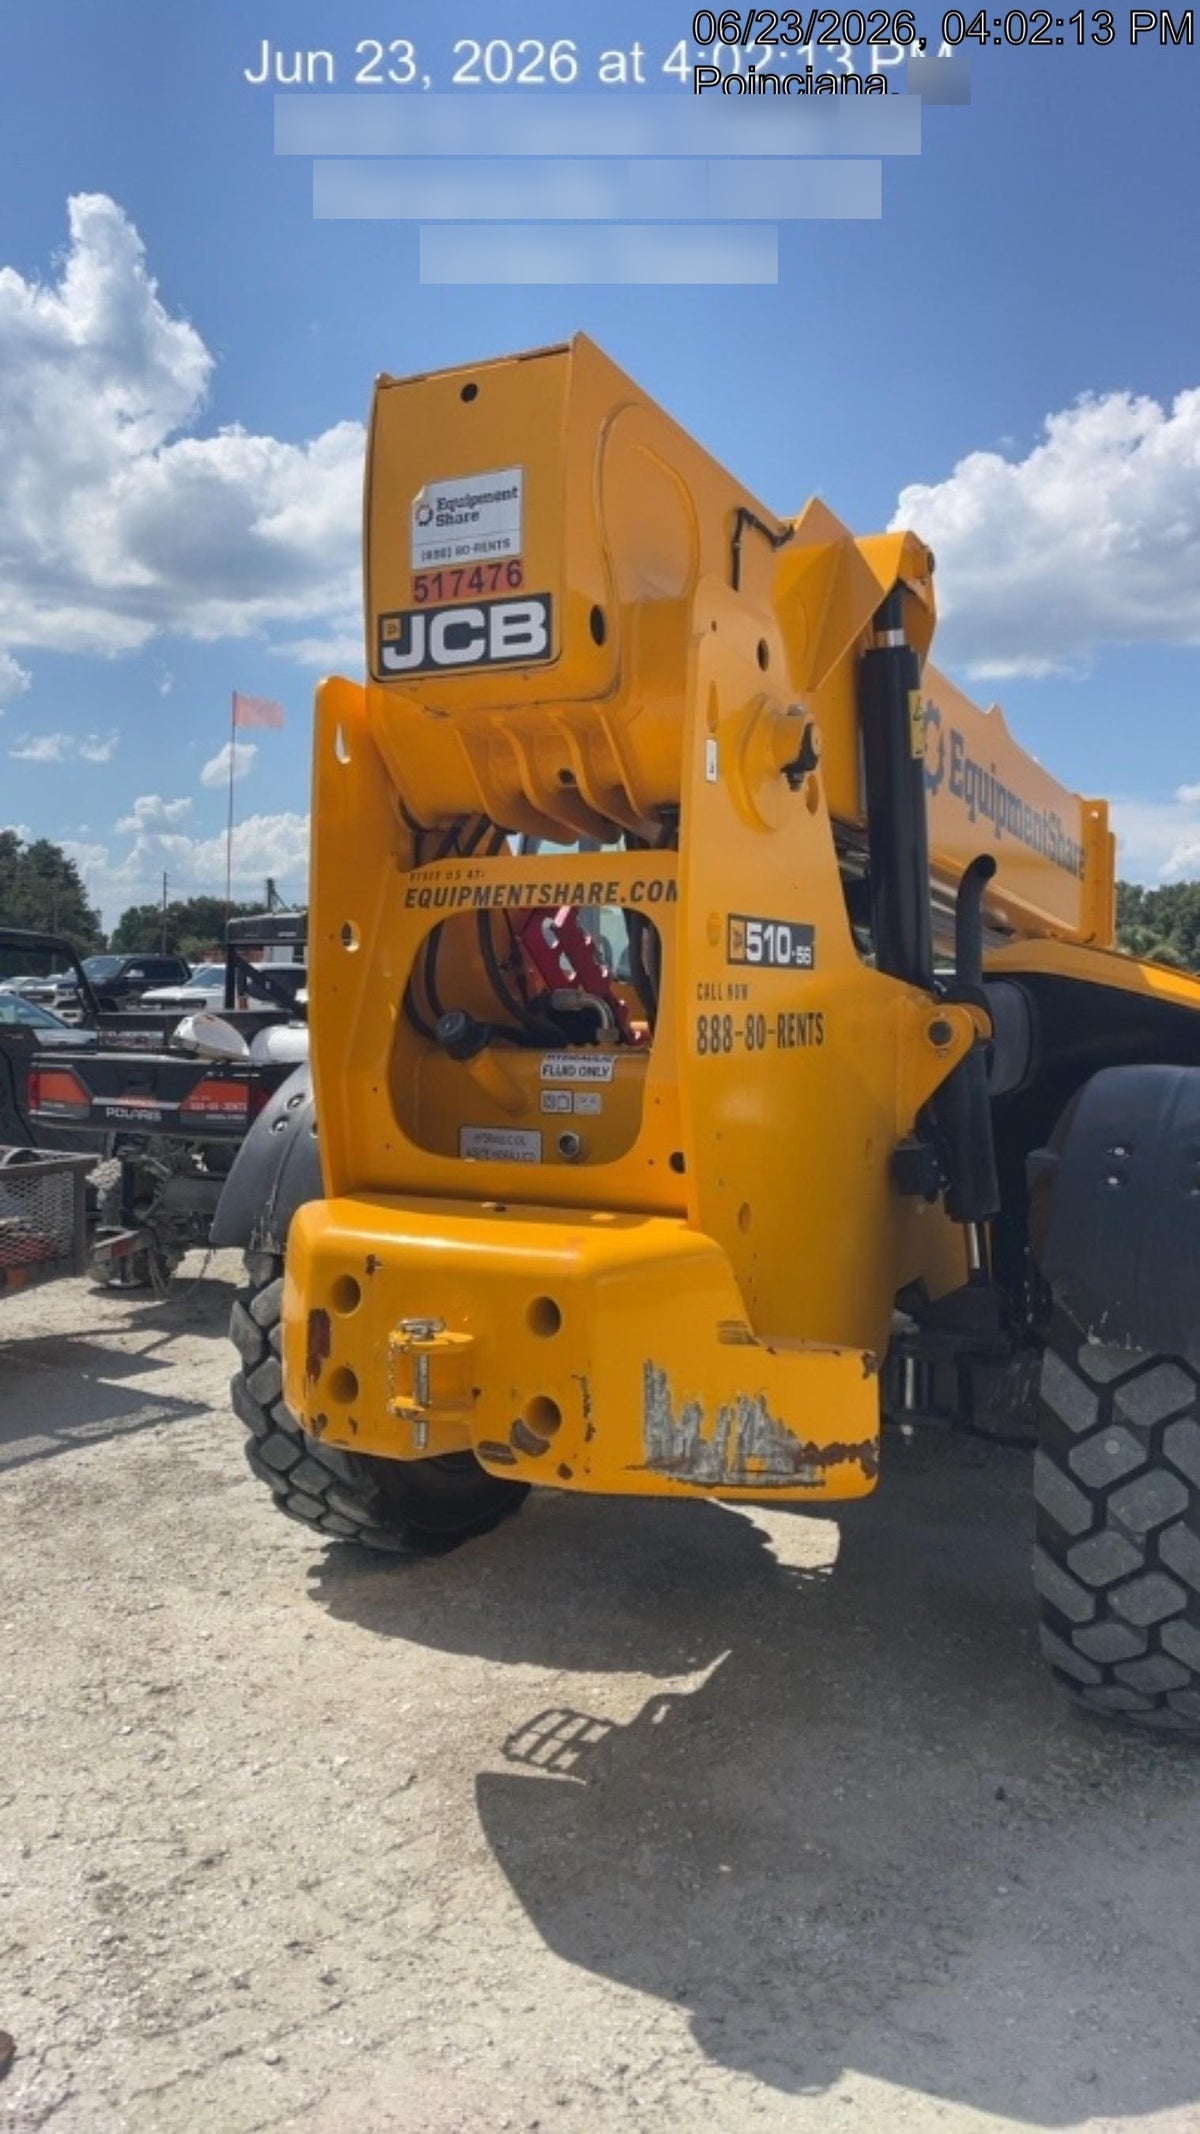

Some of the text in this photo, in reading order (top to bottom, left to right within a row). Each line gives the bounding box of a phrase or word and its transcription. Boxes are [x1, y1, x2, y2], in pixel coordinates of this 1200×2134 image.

[436, 485, 518, 512] Equipment
[436, 511, 480, 527] Share
[413, 559, 522, 603] 517476
[381, 600, 548, 670] JCB
[949, 727, 1088, 883] EquipmentShare
[697, 983, 748, 1001] CALL NOW
[697, 1011, 824, 1056] 888-80-RENTS
[579, 1065, 610, 1078] ONLY
[106, 1106, 162, 1122] POLARIS
